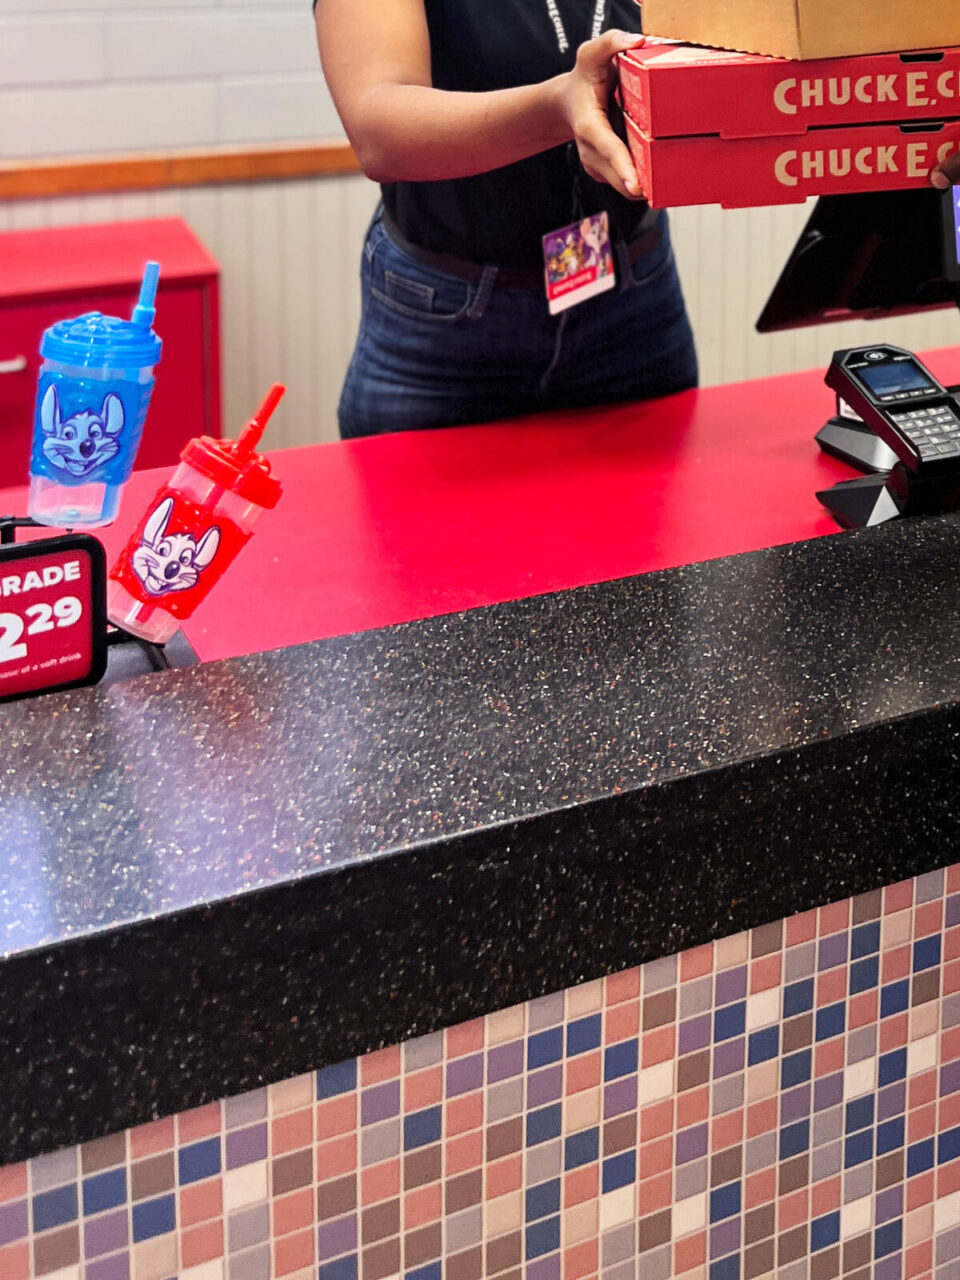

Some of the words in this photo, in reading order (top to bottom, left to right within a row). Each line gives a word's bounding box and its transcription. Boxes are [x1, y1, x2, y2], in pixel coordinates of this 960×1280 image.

[773, 74, 899, 115] CHUCK
[774, 145, 899, 187] CHUCK
[0, 560, 82, 597] RADE
